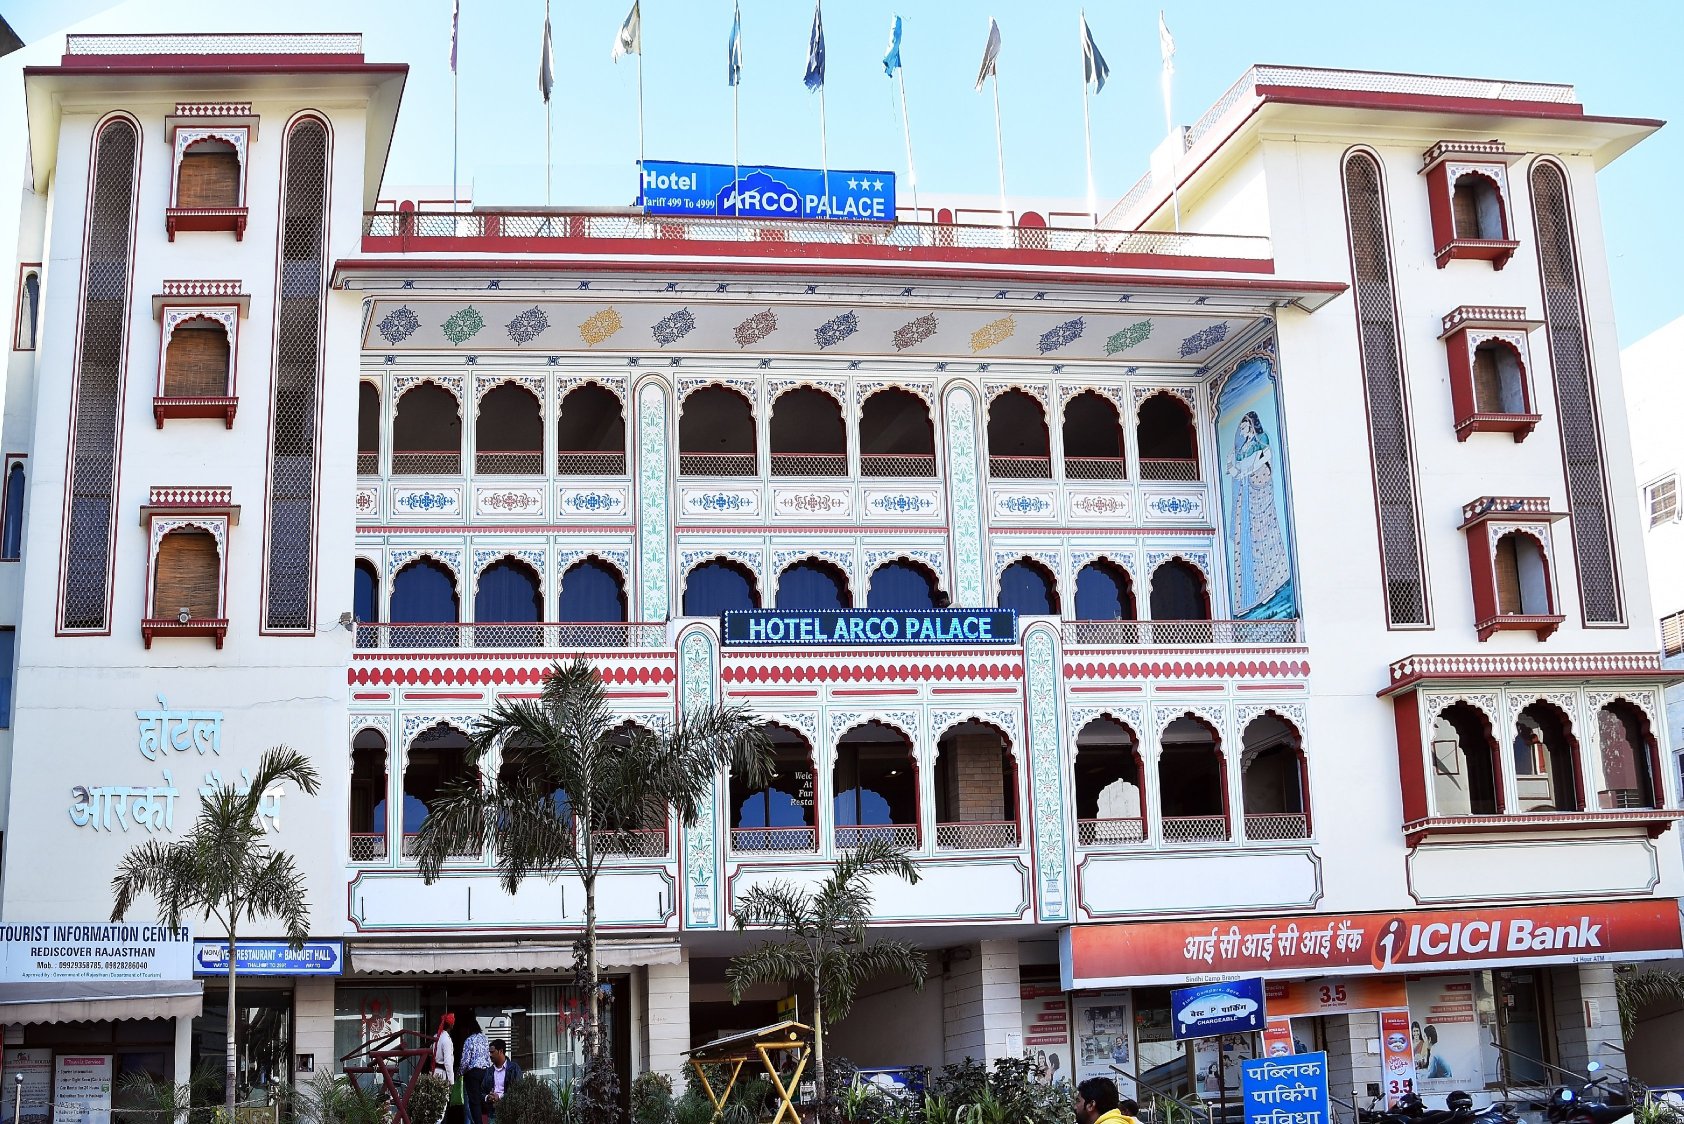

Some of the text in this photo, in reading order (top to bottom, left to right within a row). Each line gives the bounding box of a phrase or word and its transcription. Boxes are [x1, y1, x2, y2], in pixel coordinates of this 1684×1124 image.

[643, 170, 697, 190] Hotel
[644, 196, 715, 209] Tariff 499 To 4999
[724, 189, 885, 217] ARCO PALACE
[750, 616, 992, 640] HOTEL ARCO PALACE
[135, 693, 224, 761] होटल
[795, 771, 813, 779] Welc
[69, 768, 179, 832] आरको
[790, 798, 814, 806] Resta
[0, 926, 189, 942] TOURIST INFORMATION CENTER
[1183, 919, 1364, 965] आई सी आई सी आई बैंक
[1407, 920, 1501, 957] ICICI
[1507, 916, 1601, 951] Bank
[31, 947, 156, 957] REDISCOVER RAJASTHAN
[236, 949, 276, 960] RESTAURANT
[314, 949, 330, 960] HALL
[1319, 984, 1347, 1003] 3.5
[1197, 1015, 1238, 1025] CHARGEABLE
[1247, 1061, 1321, 1080] पब्लिक
[1389, 1080, 1413, 1094] 3.5
